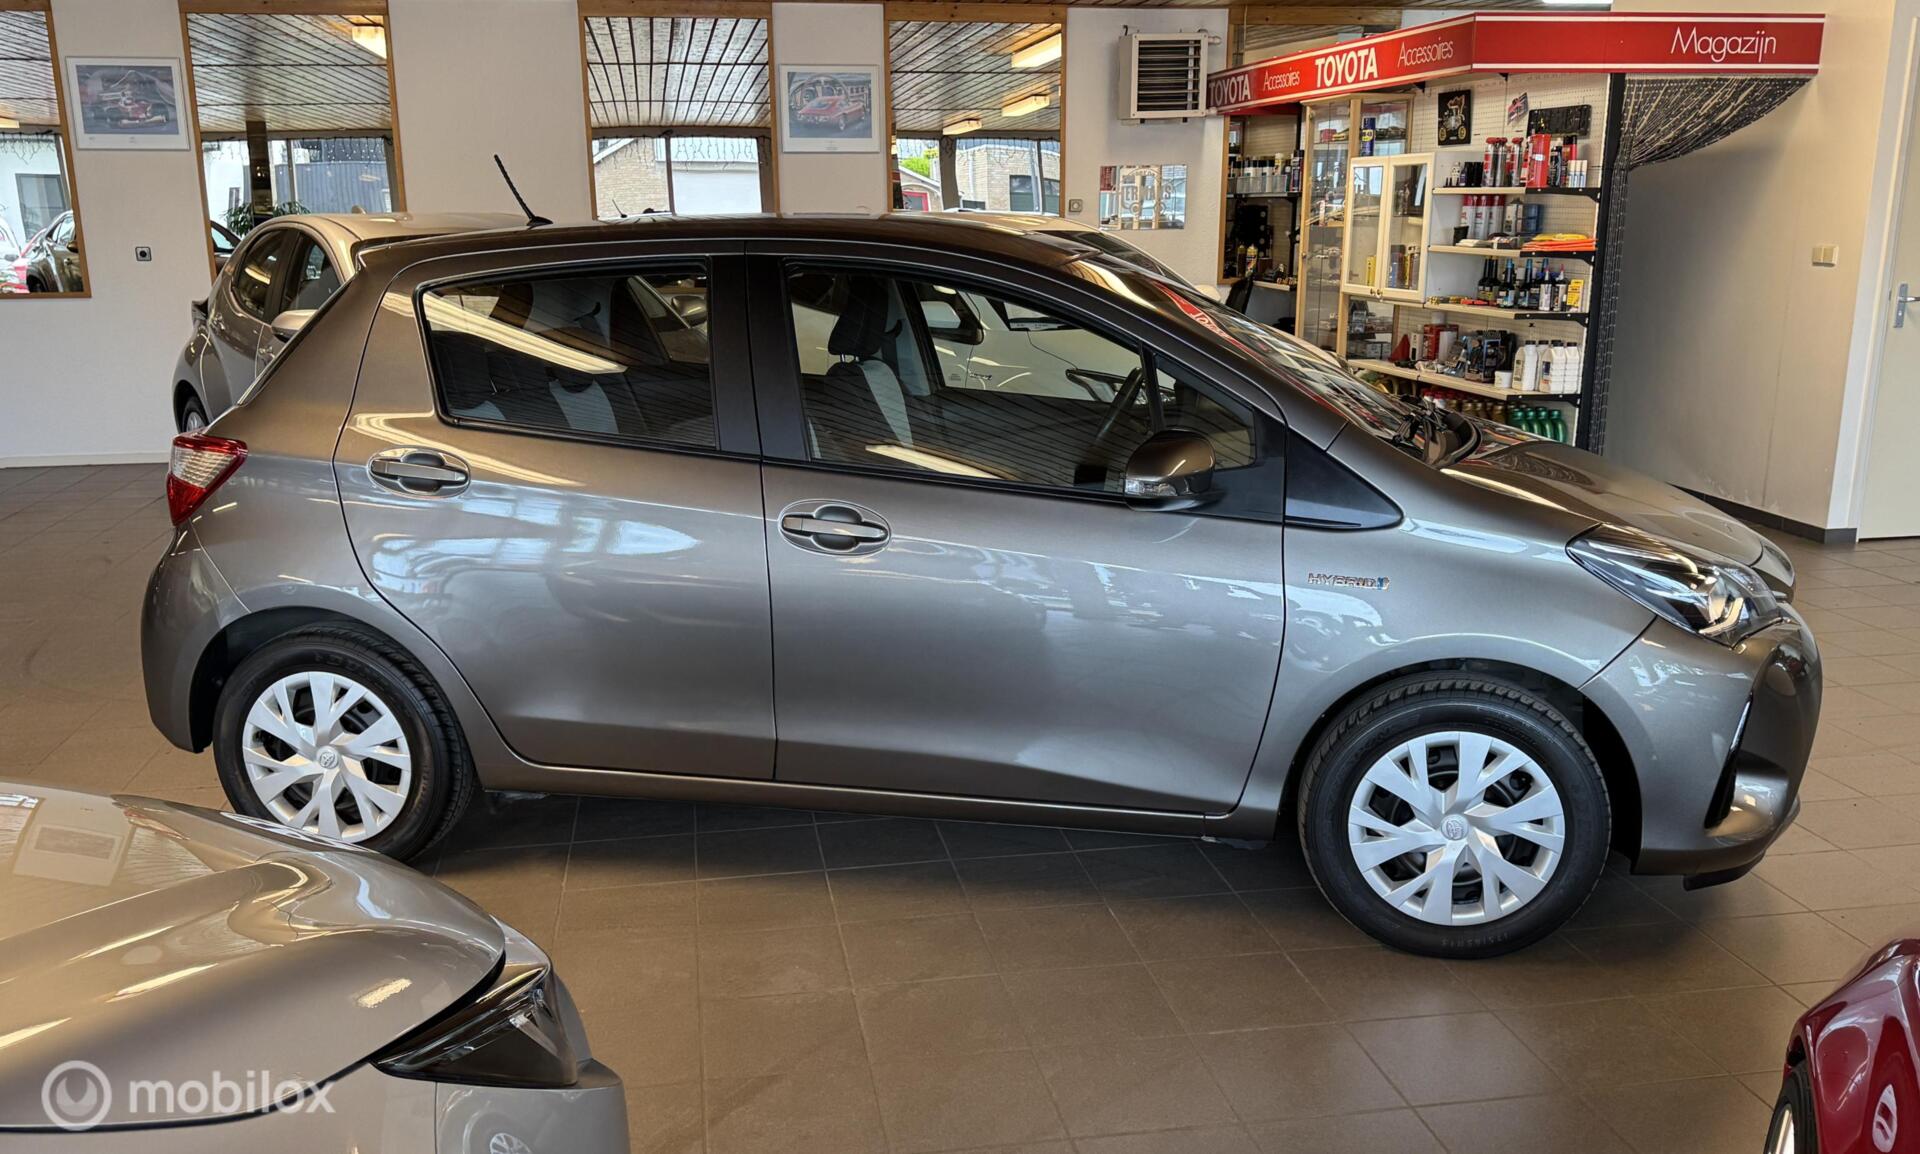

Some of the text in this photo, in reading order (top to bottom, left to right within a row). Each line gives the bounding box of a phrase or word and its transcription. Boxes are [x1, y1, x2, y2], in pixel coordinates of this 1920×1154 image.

[1669, 26, 1777, 63] Magazijn
[1209, 37, 1454, 107] TOYOTA Accessoires TOYOTA Accessoires
[1308, 572, 1378, 590] HYBRID
